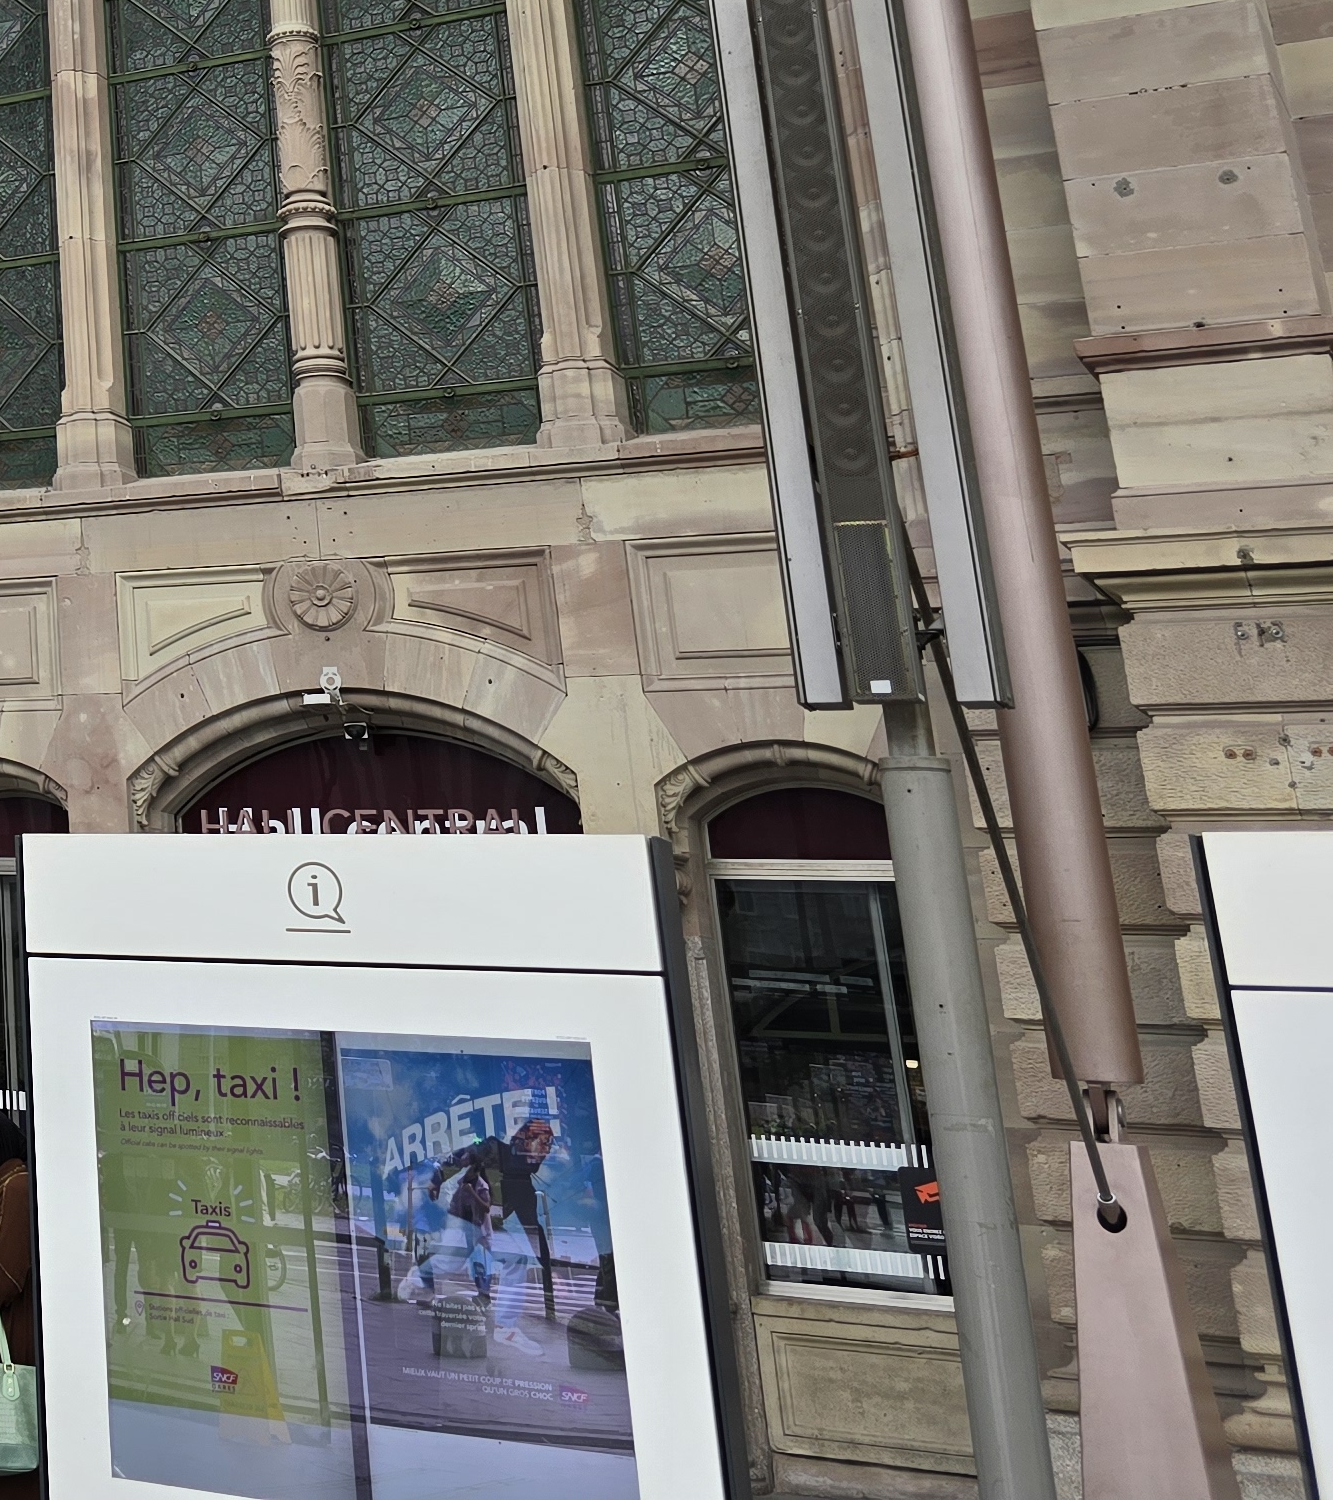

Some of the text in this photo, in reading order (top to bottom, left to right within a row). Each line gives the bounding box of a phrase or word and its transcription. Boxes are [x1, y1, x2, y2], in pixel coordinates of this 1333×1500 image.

[120, 1059, 300, 1106] Hep, taxi !
[120, 1108, 304, 1130] Les taxis officiels sont reconnaissables
[120, 1121, 125, 1131] à
[129, 1122, 146, 1132] leur
[149, 1124, 176, 1136] signal
[383, 1089, 532, 1180] ARRÊTE
[191, 1199, 231, 1217] Taxis
[213, 1372, 236, 1382] SNCF
[403, 1367, 552, 1391] MIEUX VAUT UN PETIT COUP DE PRESSION
[482, 1385, 507, 1395] QU'UN
[508, 1388, 530, 1398] GROS
[561, 1391, 588, 1402] SNCF
